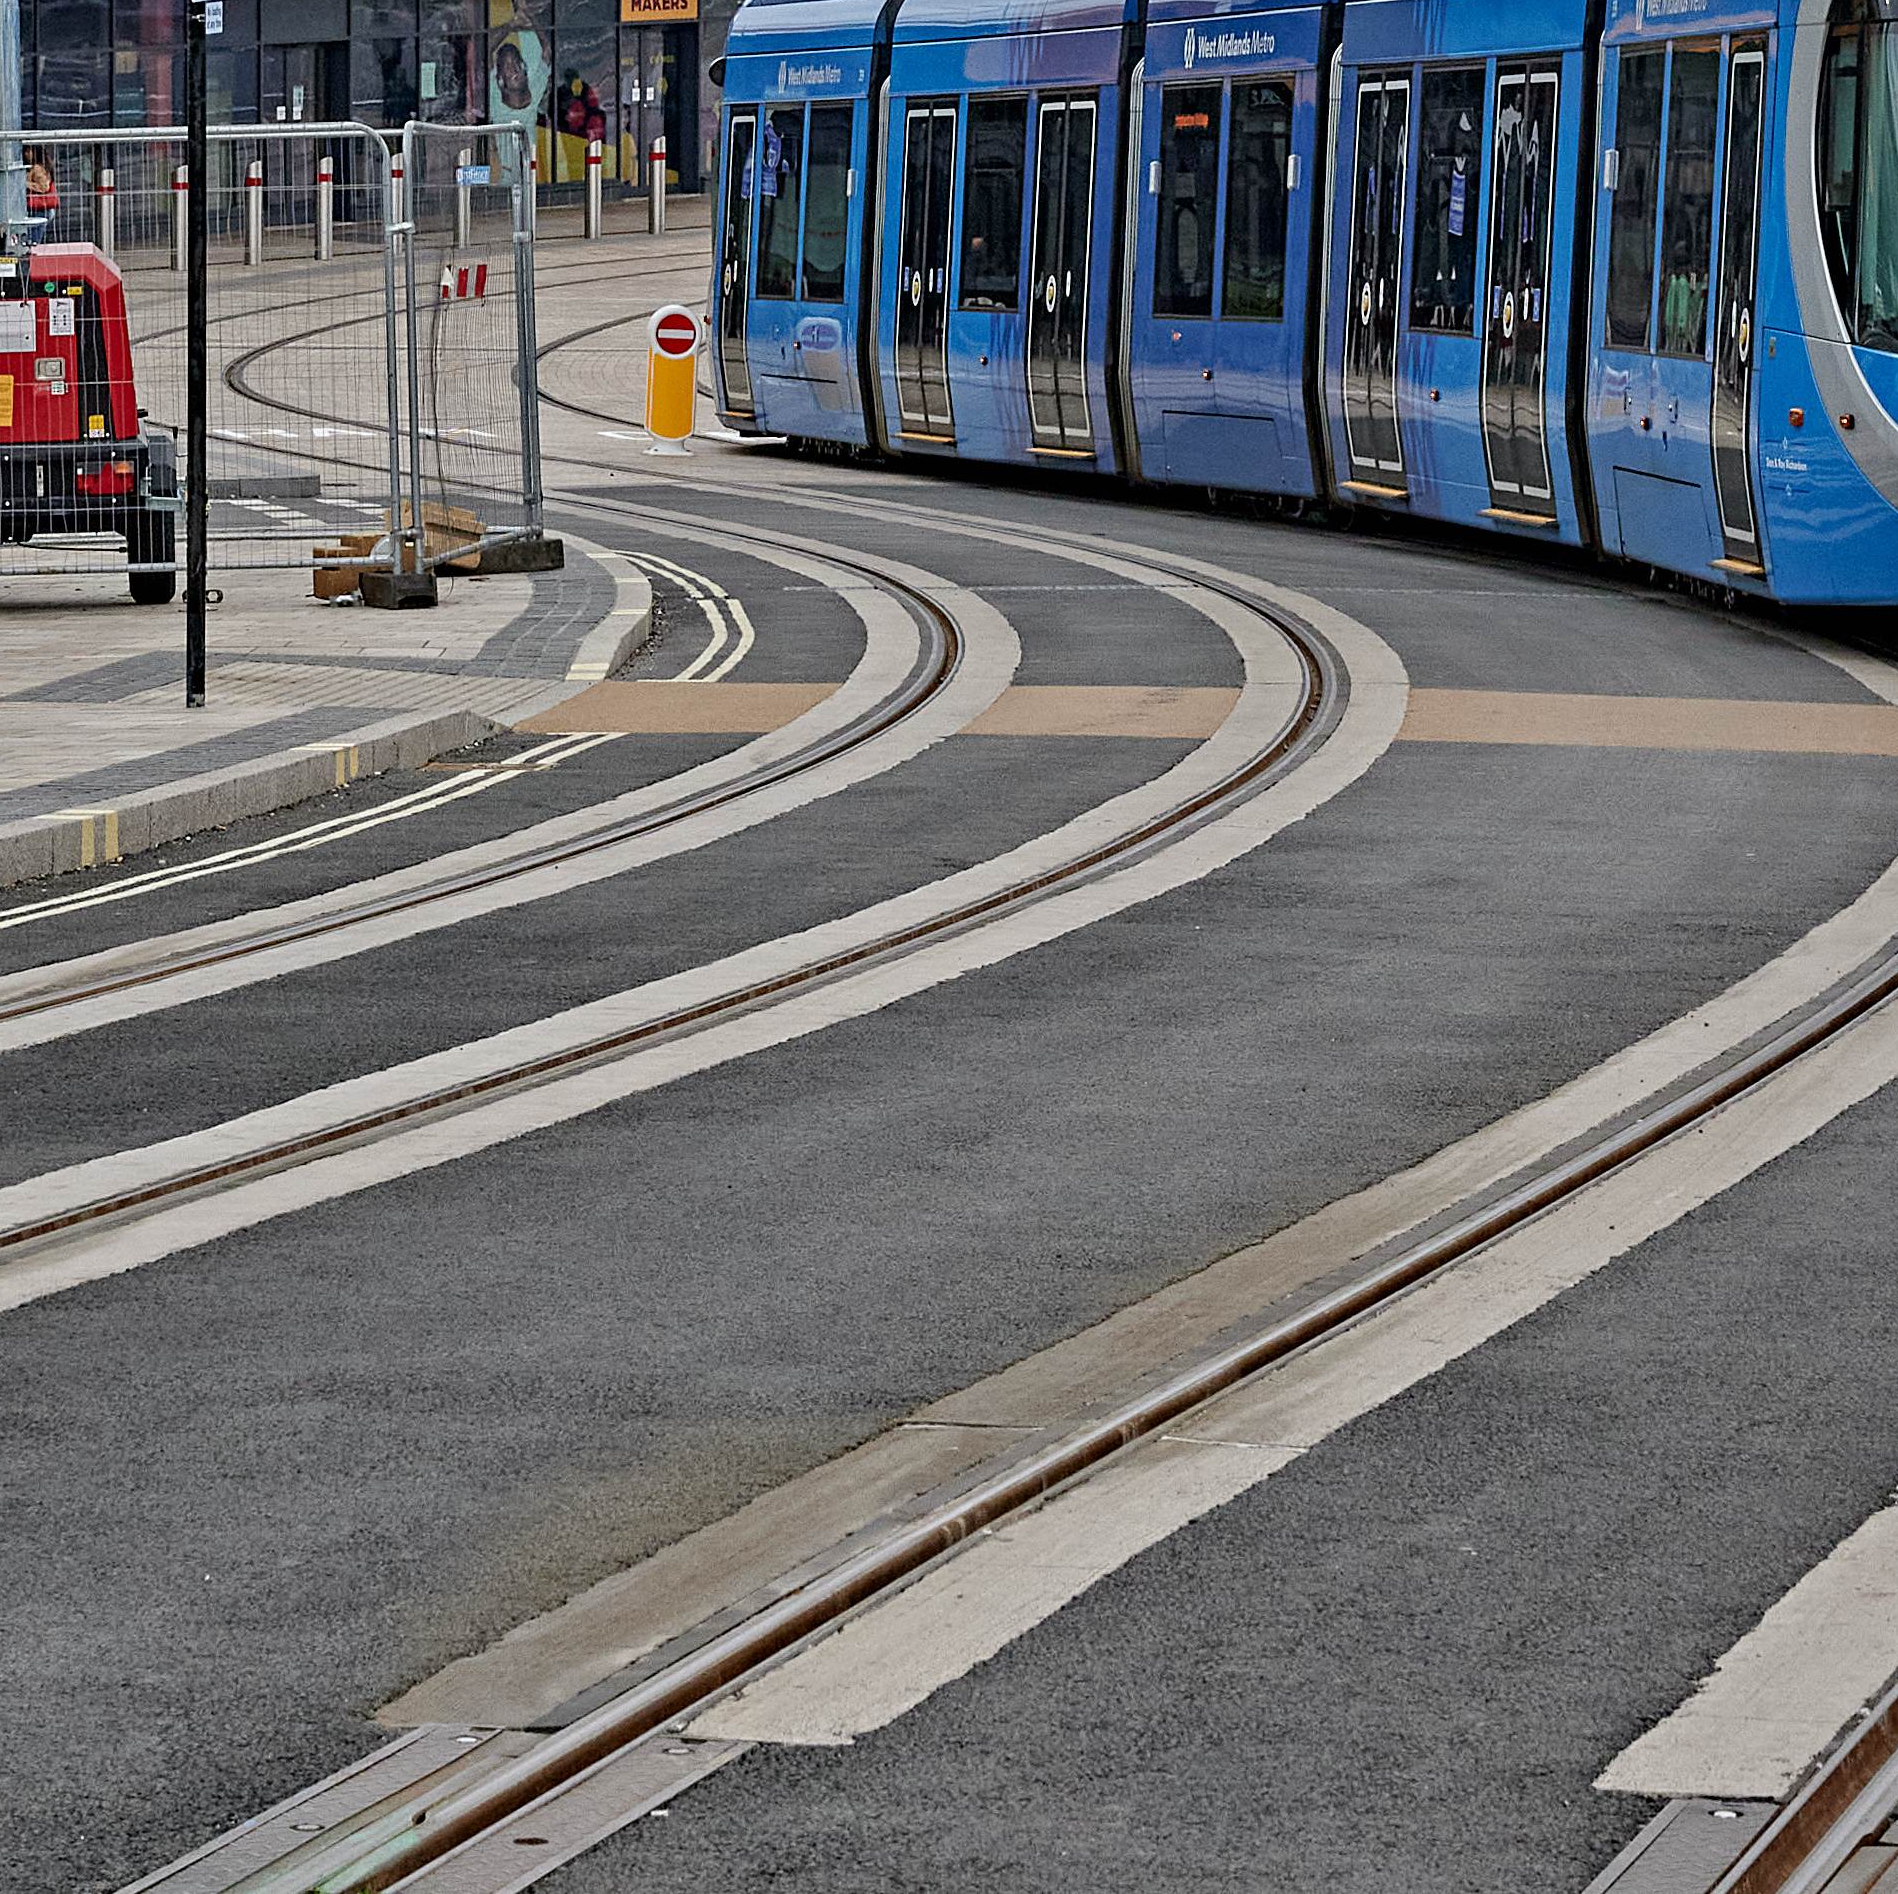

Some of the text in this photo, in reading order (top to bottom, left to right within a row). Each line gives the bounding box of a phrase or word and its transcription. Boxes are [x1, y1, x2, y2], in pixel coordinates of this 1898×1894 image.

[1197, 30, 1275, 59] West Midlands Metro
[788, 67, 802, 86] West
